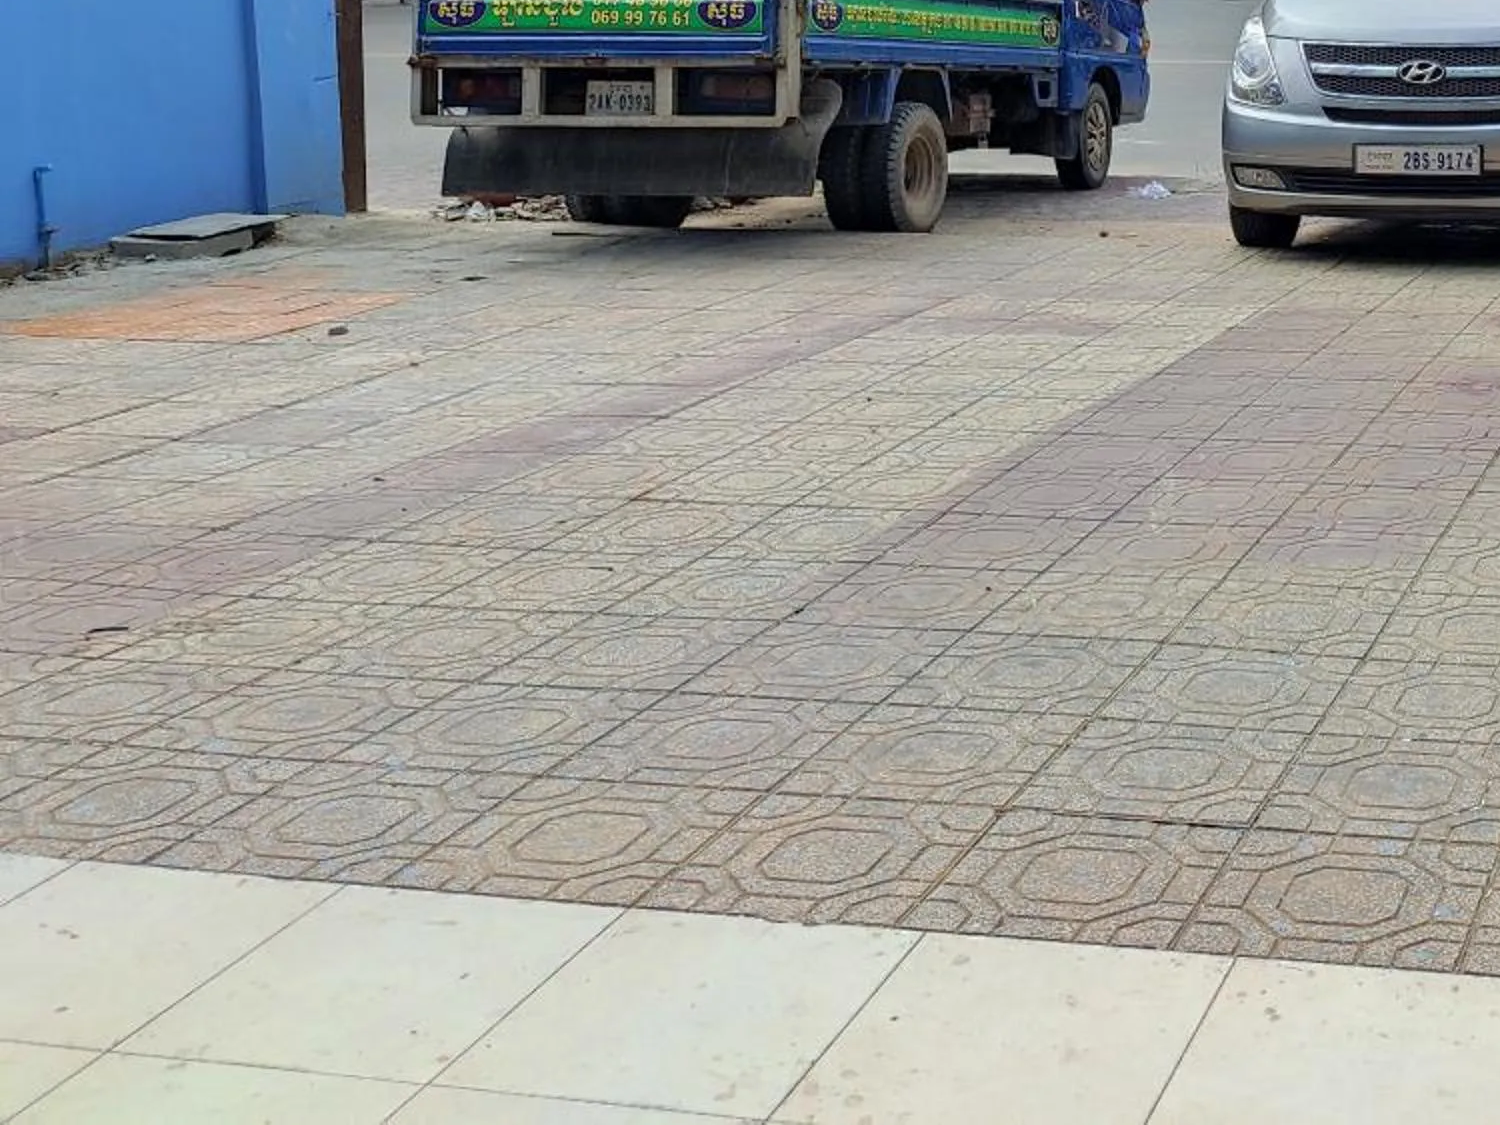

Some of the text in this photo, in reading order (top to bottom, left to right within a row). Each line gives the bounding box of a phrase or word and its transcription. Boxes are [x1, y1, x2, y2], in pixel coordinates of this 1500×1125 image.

[591, 9, 690, 25] 069 99 76 61
